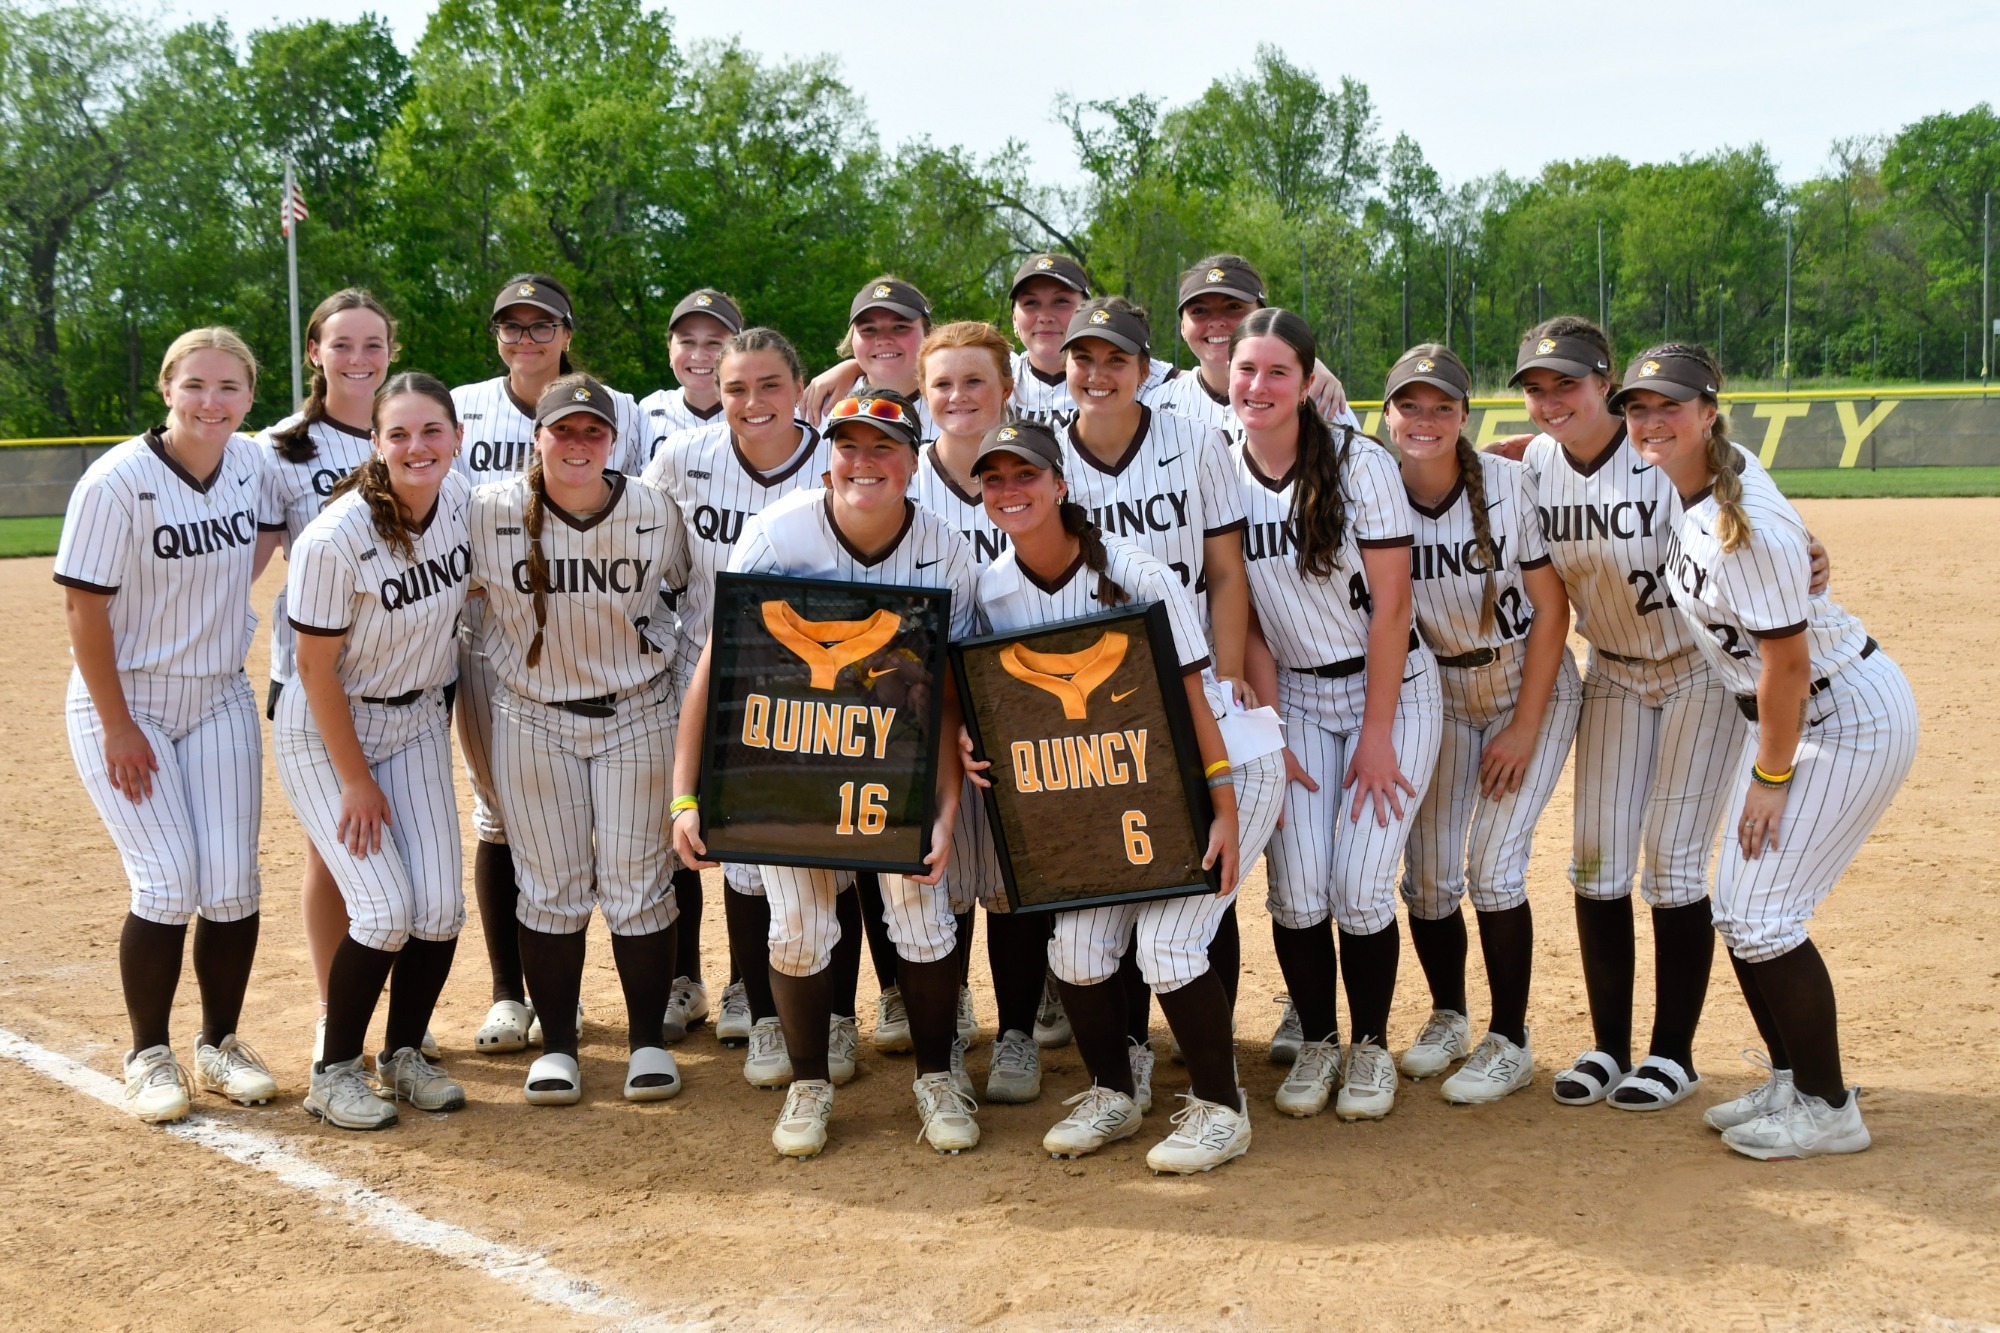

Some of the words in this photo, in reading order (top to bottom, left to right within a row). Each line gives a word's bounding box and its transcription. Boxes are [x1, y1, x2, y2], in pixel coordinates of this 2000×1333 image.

[381, 541, 471, 613] QUINCY
[742, 694, 896, 760] QUINCY
[1010, 728, 1148, 794] QUINCY
[836, 781, 889, 836] 16
[1121, 809, 1154, 865] 6
